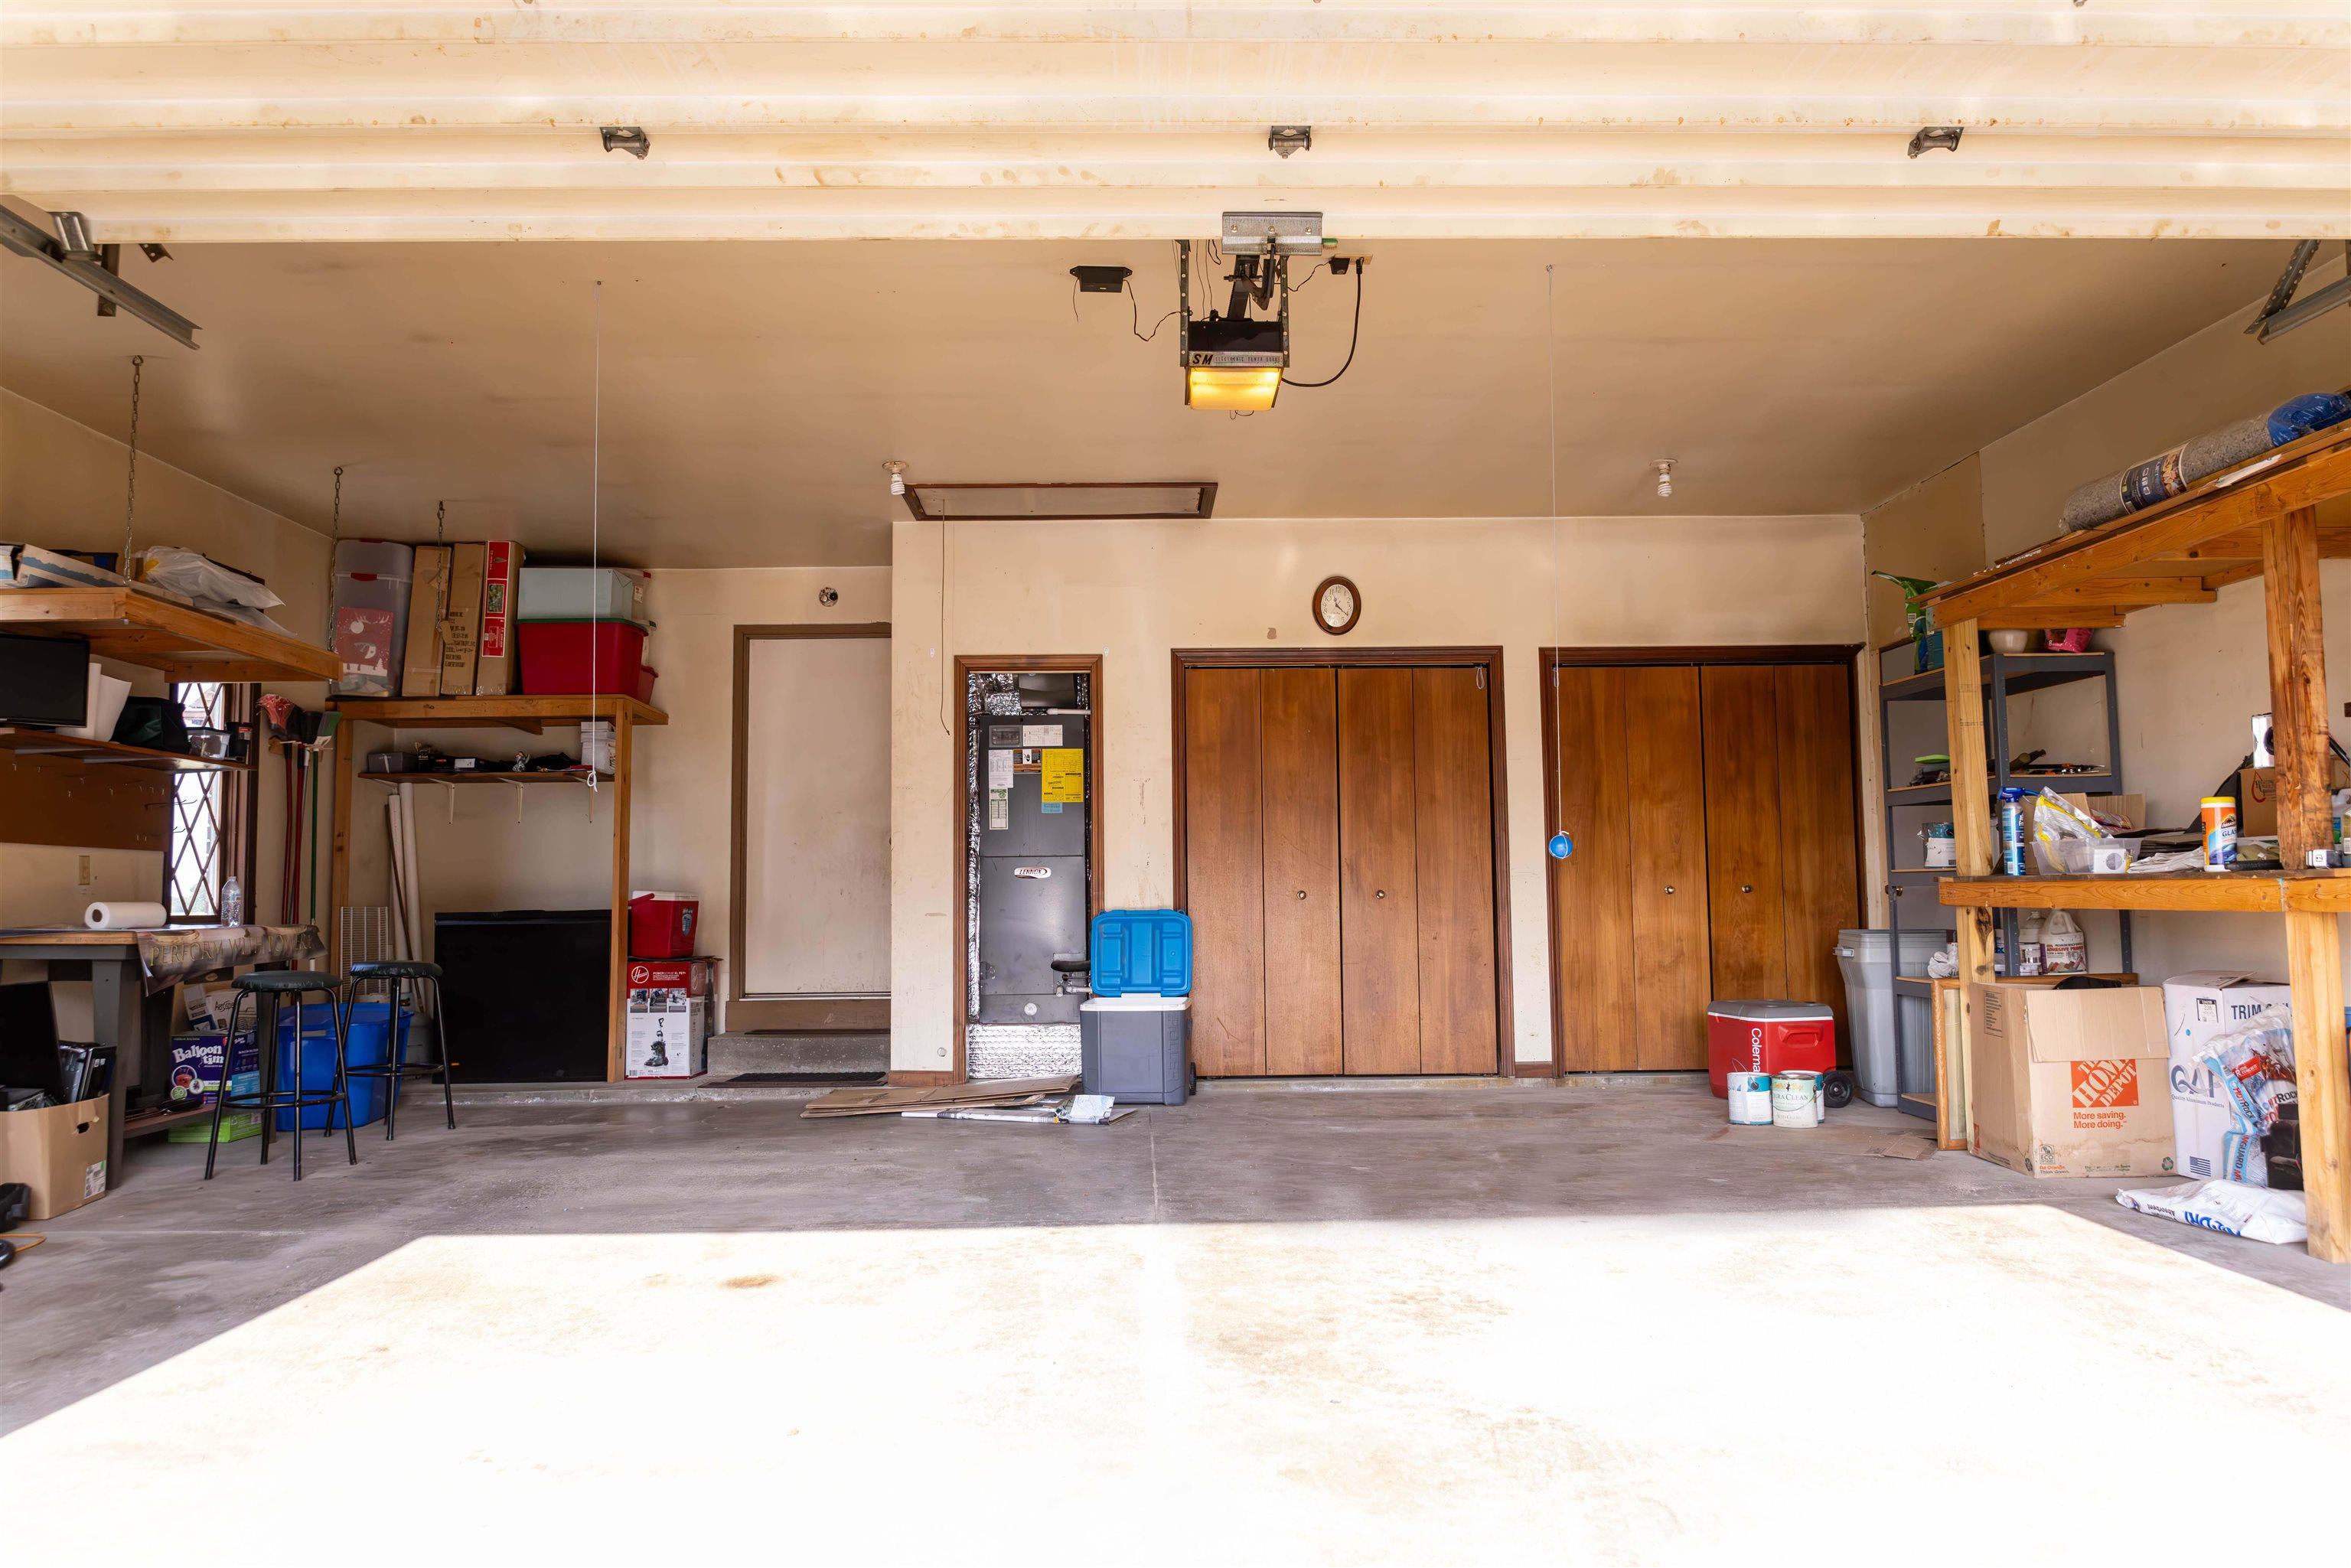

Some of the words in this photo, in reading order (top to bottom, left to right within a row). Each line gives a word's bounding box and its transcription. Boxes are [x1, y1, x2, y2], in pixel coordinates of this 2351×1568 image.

[1192, 354, 1213, 365] SM
[150, 940, 225, 967] PERFORM
[228, 936, 263, 958] WITH
[172, 1045, 223, 1064] Balloon
[1751, 1028, 1762, 1072] Colema
[202, 1054, 225, 1064] tim
[2098, 1064, 2137, 1107] DEPOT
[2097, 1110, 2126, 1120] saving.
[2073, 1120, 2096, 1129] More
[2097, 1120, 2123, 1130] doing.
